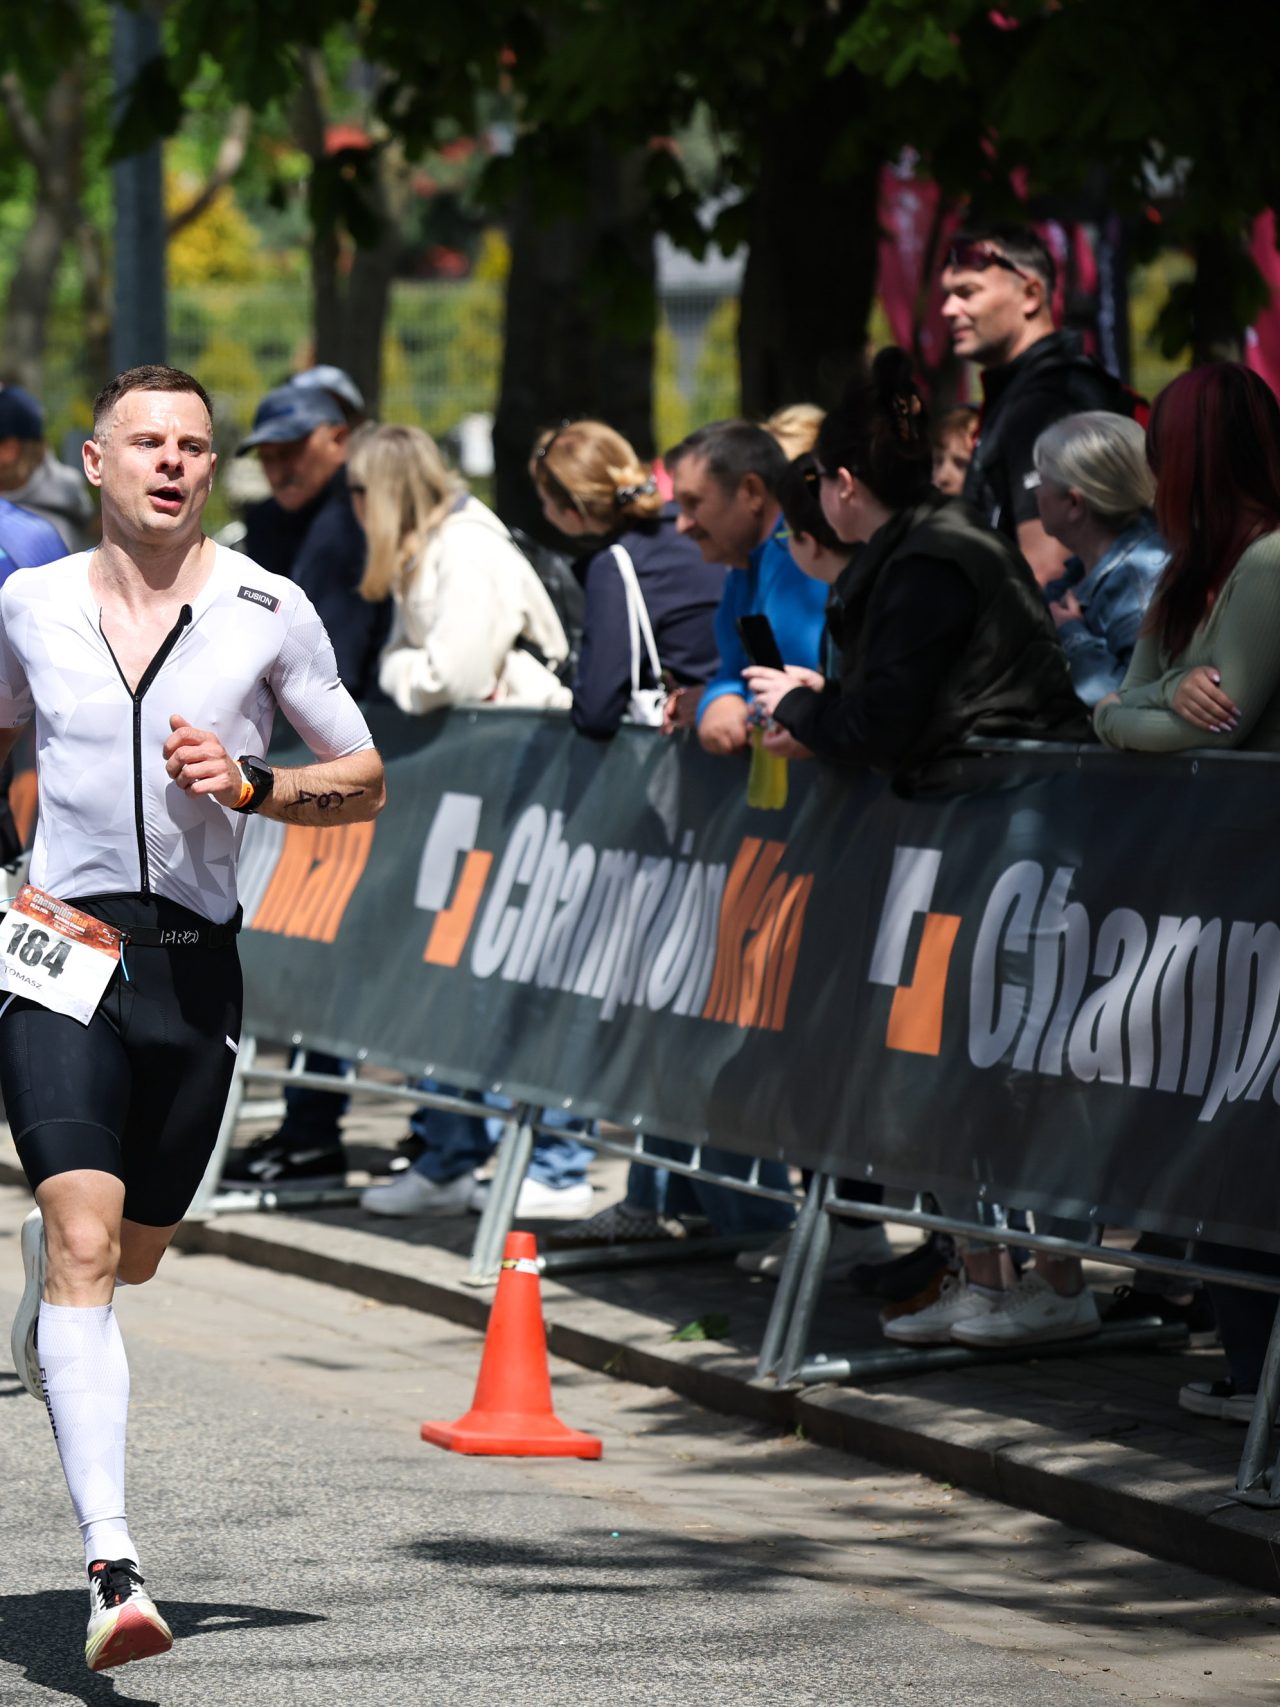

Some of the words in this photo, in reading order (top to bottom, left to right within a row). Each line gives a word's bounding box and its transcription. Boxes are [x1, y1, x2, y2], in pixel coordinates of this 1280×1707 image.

[243, 589, 273, 606] FUSION
[471, 803, 815, 1032] ChampionMan
[3, 965, 43, 989] TOMASZ
[6, 922, 73, 979] 184
[969, 860, 1280, 1122] Champ
